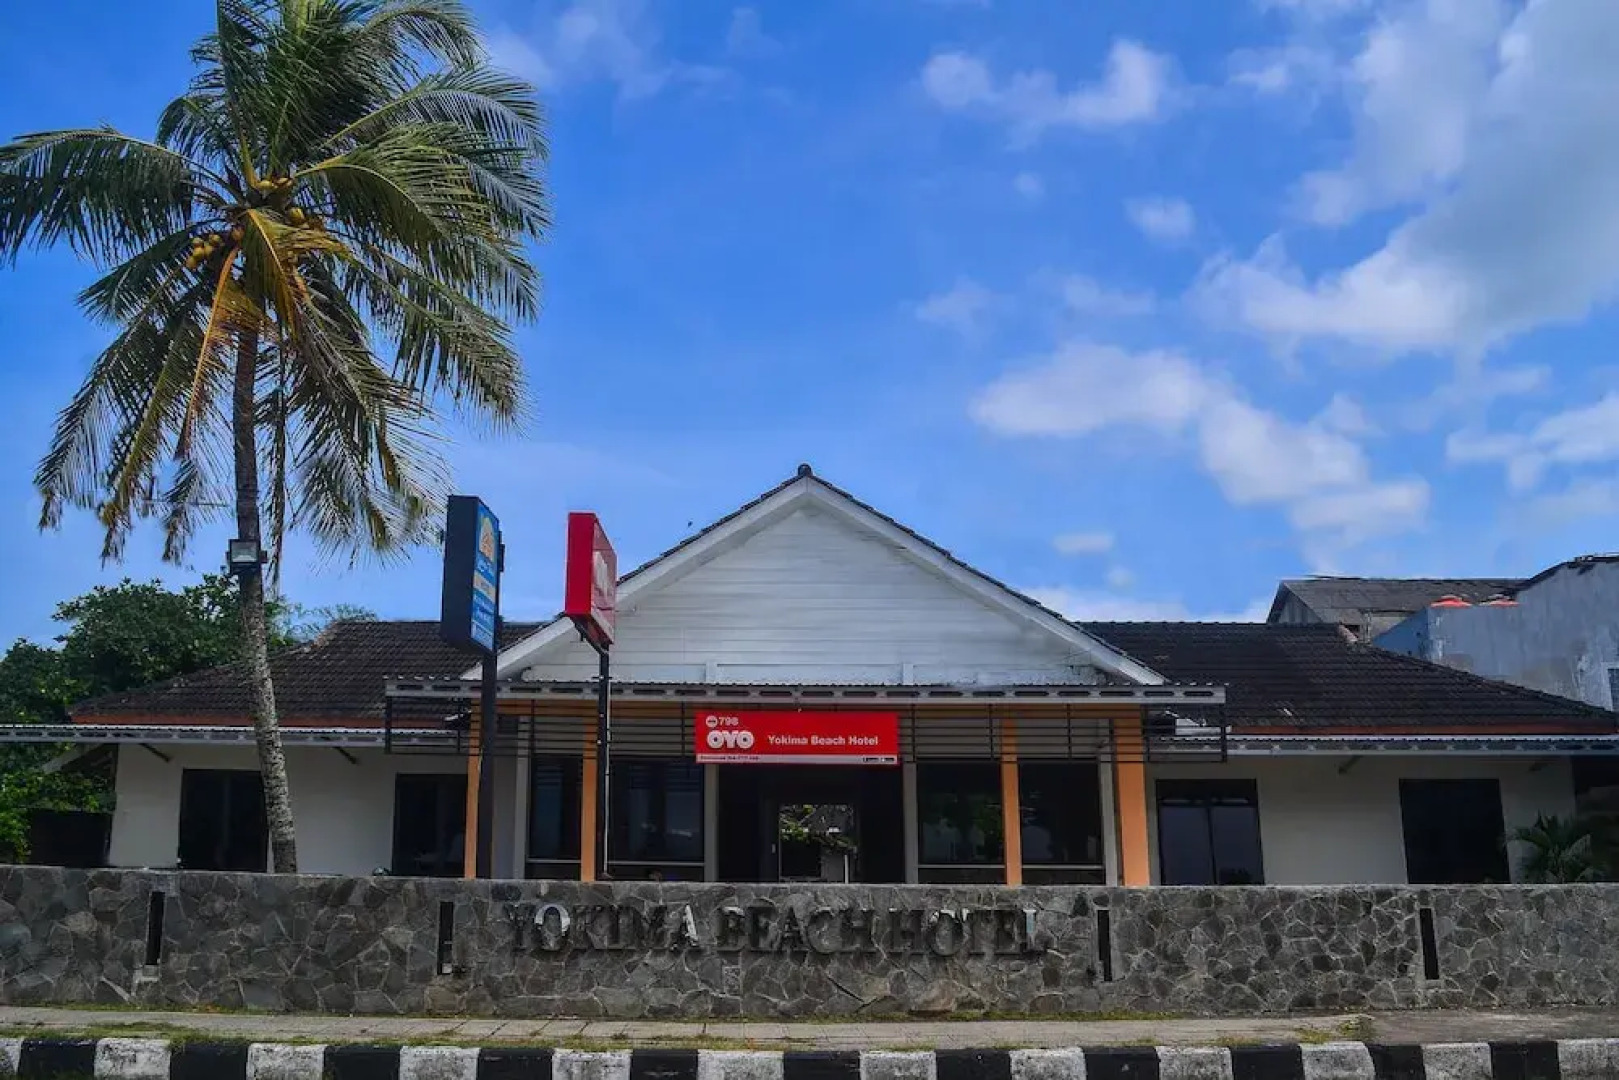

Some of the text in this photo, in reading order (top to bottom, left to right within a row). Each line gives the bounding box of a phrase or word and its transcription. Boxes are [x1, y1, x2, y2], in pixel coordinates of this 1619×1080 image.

[706, 730, 754, 749] OYO
[768, 734, 879, 747] Yokima Beach Hotel
[503, 904, 1048, 956] YOKIMA BEACH HOTEL
